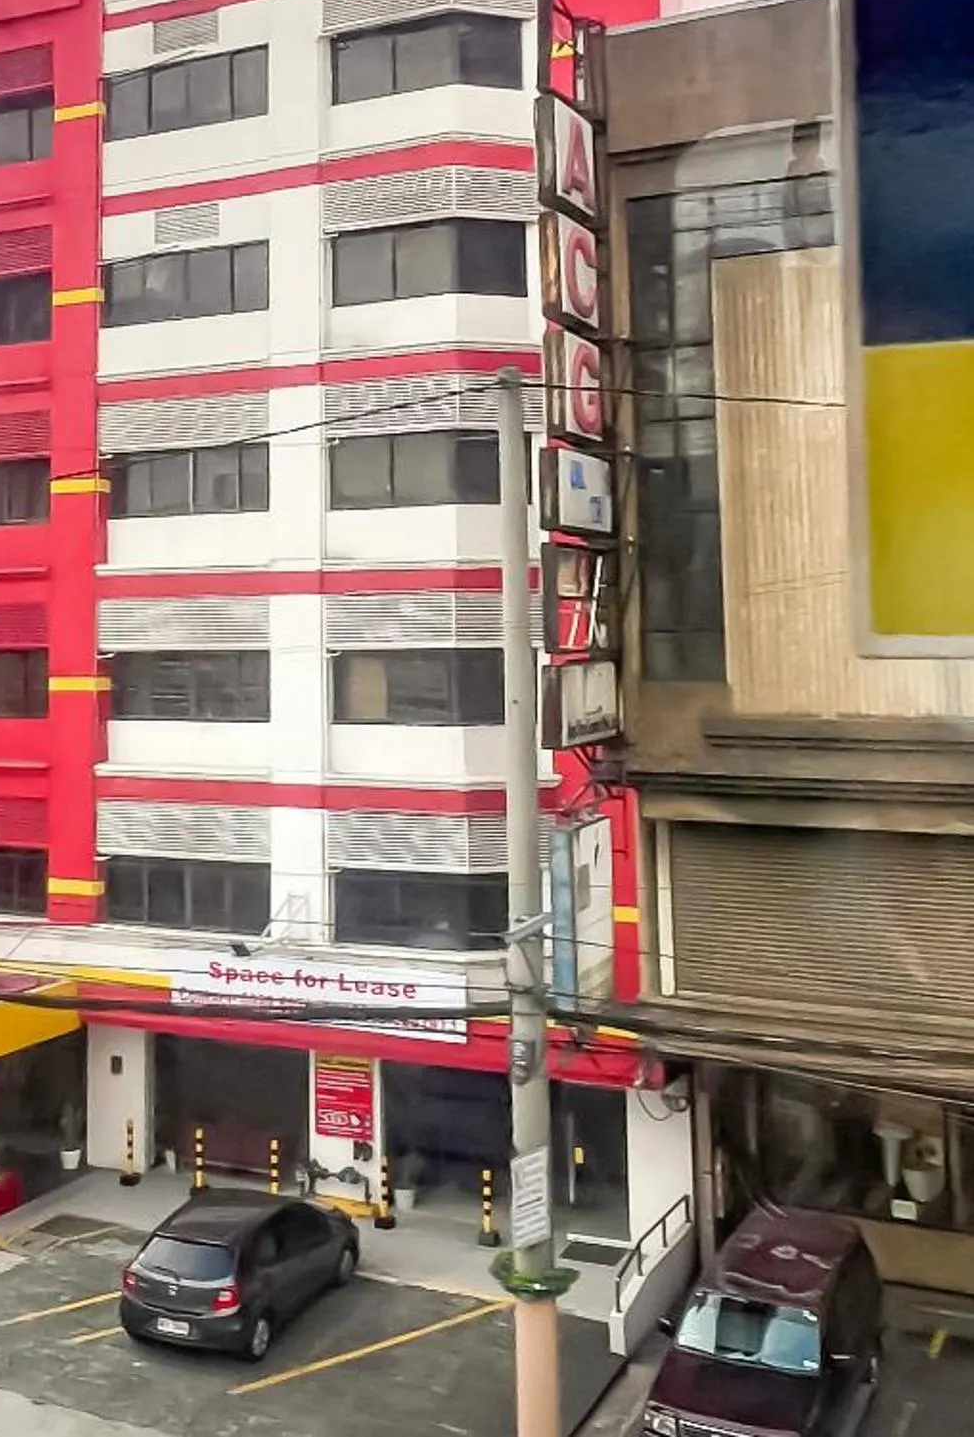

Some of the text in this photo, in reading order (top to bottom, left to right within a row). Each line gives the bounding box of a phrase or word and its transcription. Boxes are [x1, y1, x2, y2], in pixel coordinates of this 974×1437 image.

[208, 961, 285, 985] Space
[294, 968, 328, 990] for
[338, 972, 417, 999] Lease
